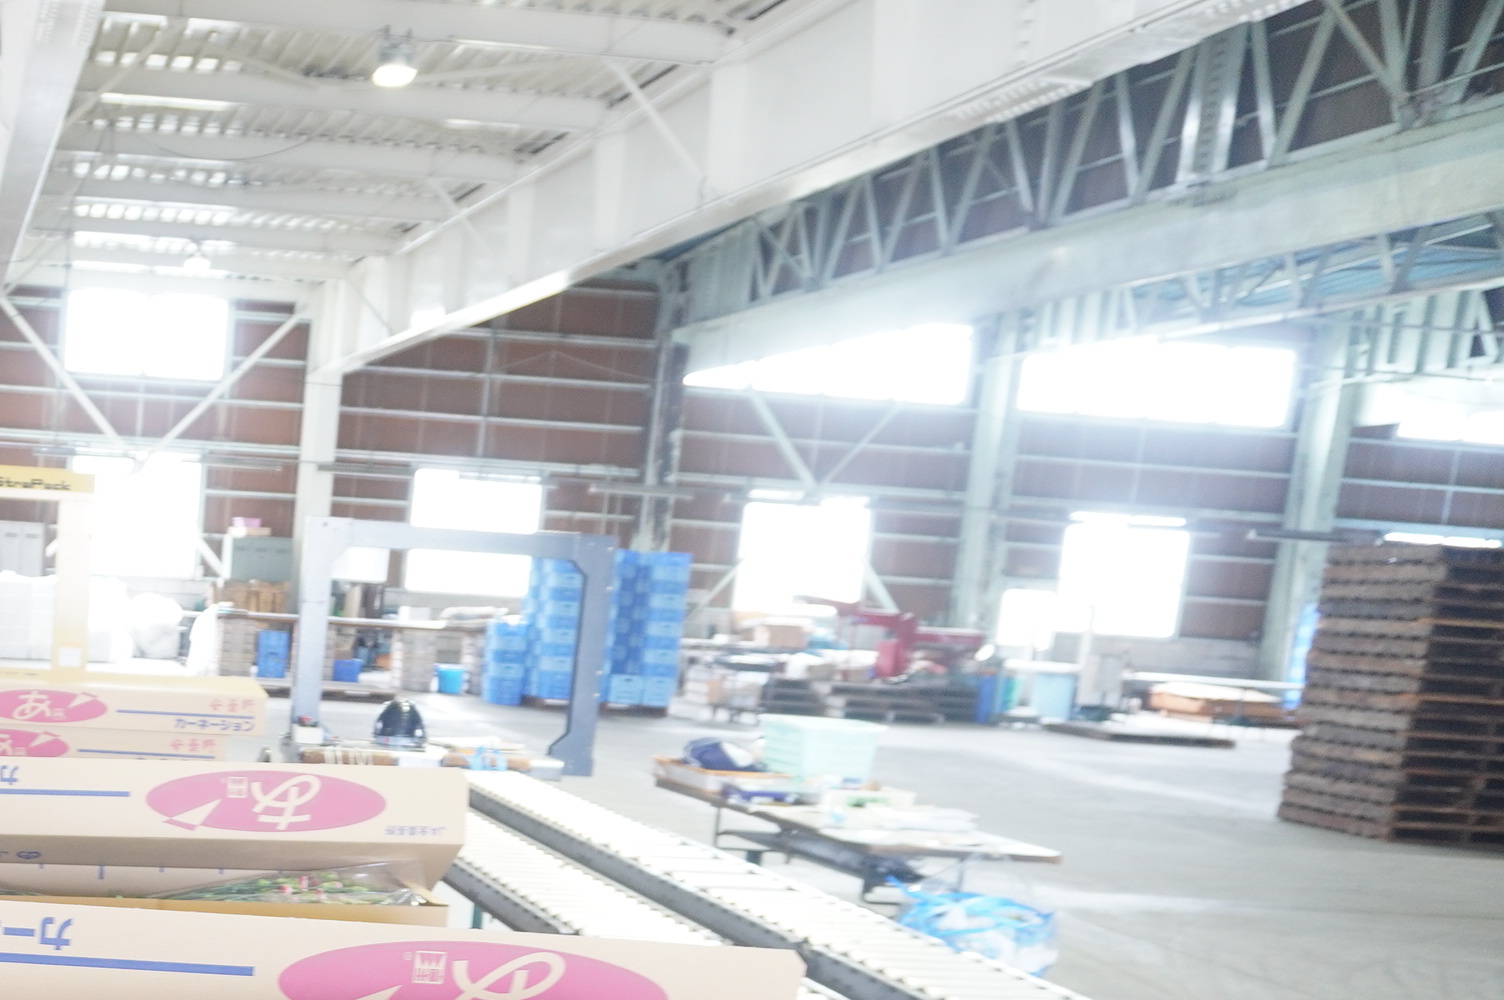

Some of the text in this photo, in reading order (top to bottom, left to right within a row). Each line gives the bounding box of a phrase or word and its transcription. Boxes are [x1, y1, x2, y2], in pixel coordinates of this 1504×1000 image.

[174, 718, 256, 732] カーネーション
[251, 774, 322, 831] あ
